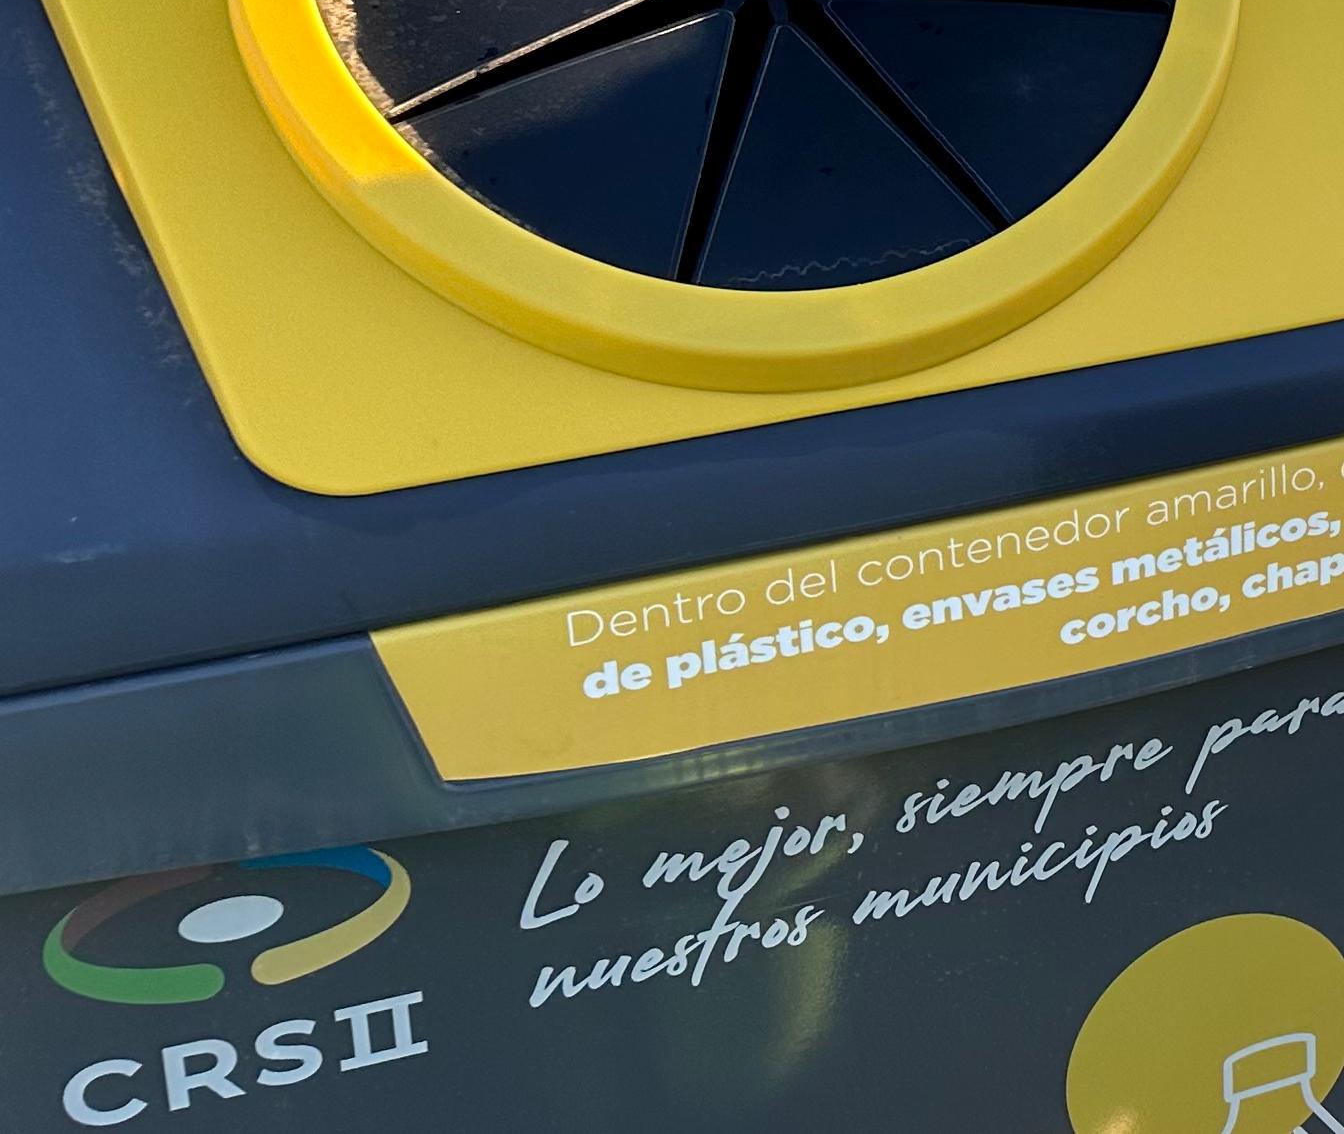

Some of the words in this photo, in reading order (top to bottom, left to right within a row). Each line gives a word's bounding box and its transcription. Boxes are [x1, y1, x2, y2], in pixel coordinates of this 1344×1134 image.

[566, 587, 746, 647] Dentro
[765, 559, 838, 606] del
[857, 507, 1130, 586] contenedor
[1146, 463, 1325, 526] amarillo,
[582, 659, 653, 700] de
[665, 615, 890, 690] plástico,
[902, 565, 1100, 631] envases
[1111, 510, 1342, 586] metálicos,
[1060, 585, 1231, 646] corcho,
[519, 839, 605, 930] Lo
[642, 806, 865, 902] mejor,
[896, 738, 1173, 834] siempre
[529, 892, 825, 1008] nuestros
[853, 799, 1229, 925] municipios
